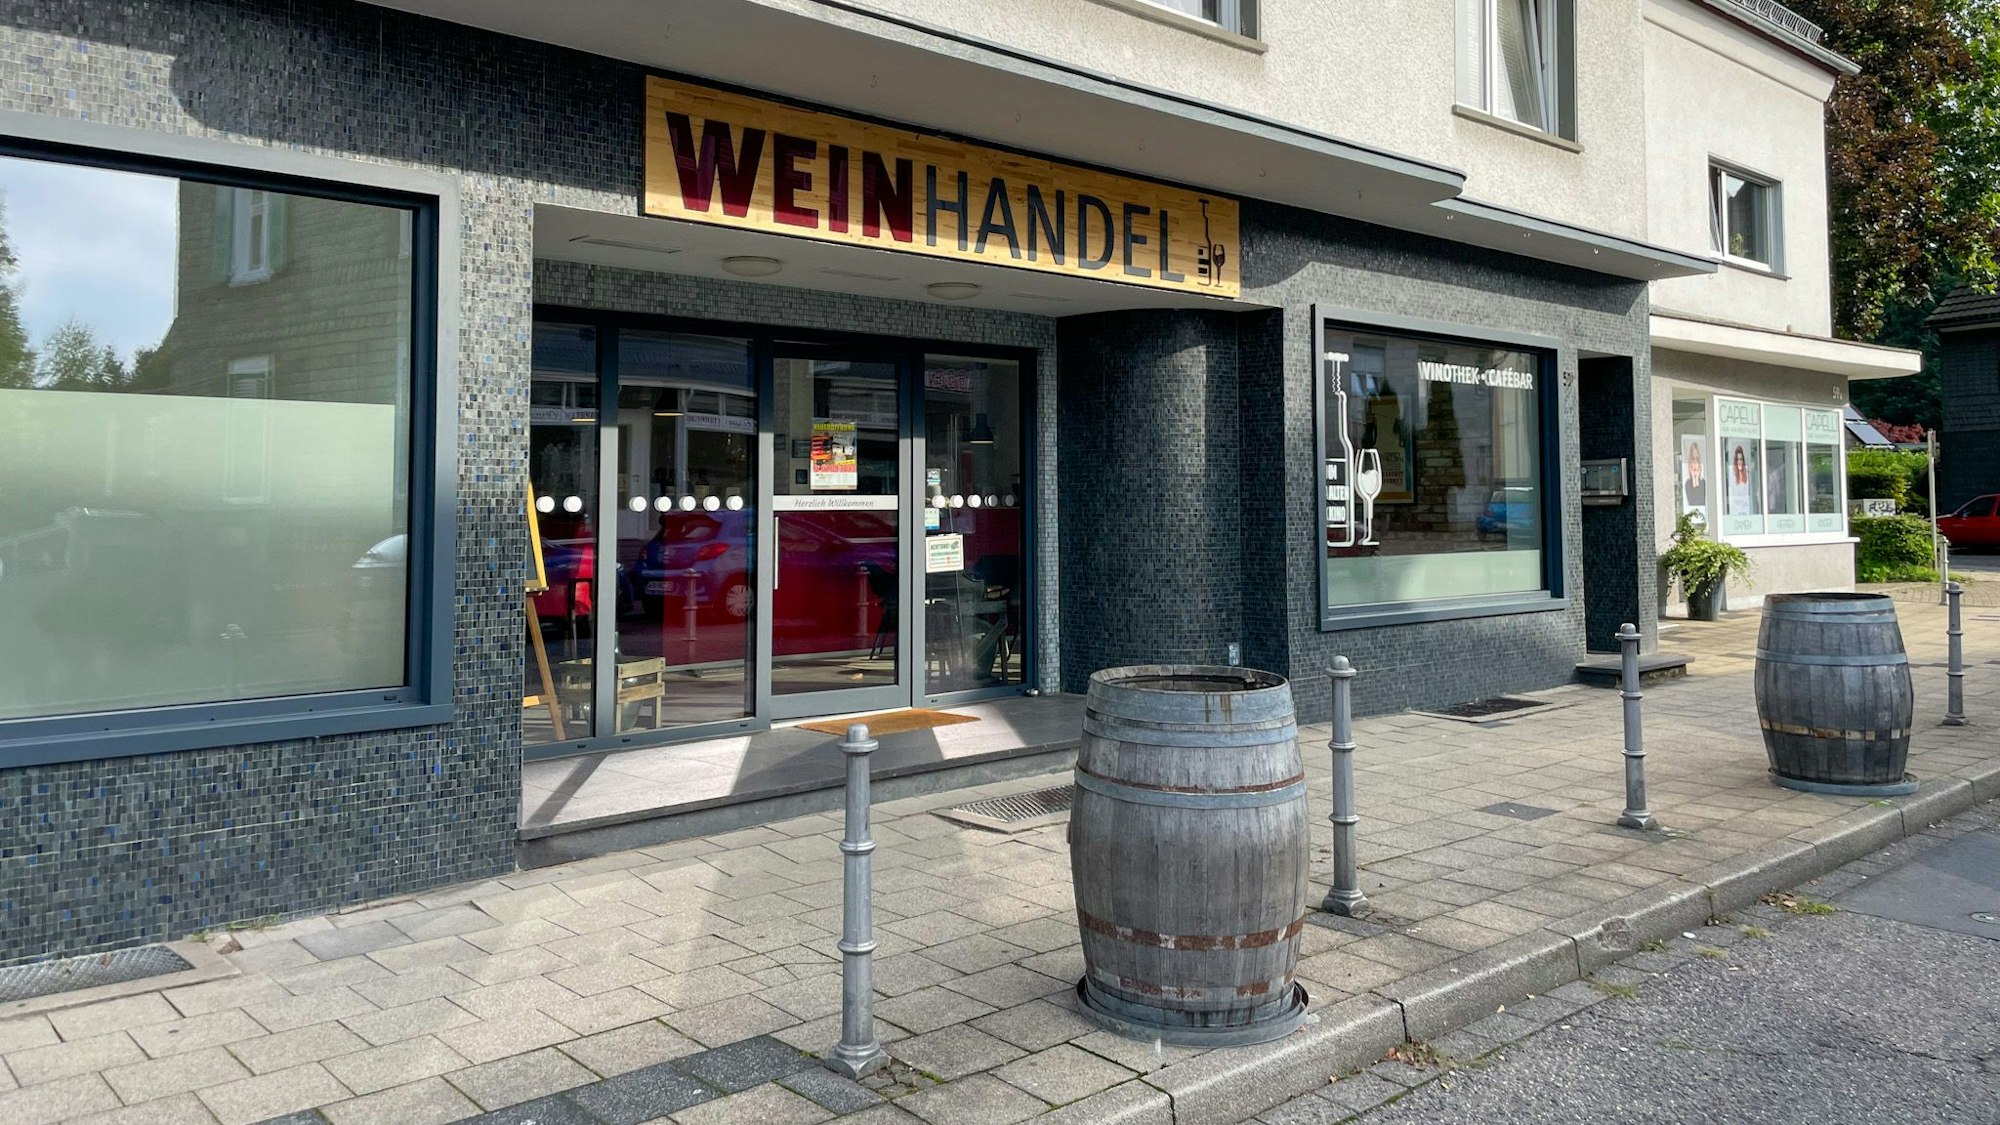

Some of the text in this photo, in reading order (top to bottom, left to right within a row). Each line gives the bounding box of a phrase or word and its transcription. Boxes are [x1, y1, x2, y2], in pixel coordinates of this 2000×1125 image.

[665, 111, 1186, 283] WEINHANDEL
[1420, 361, 1534, 390] VINOTHEK CAFÉBAR
[1719, 404, 1759, 426] CAPELLI
[1805, 413, 1840, 432] CAPELLI
[1328, 485, 1350, 500] ALTEN
[794, 498, 875, 508] Herzlich Willkommen
[1328, 506, 1346, 522] KINO
